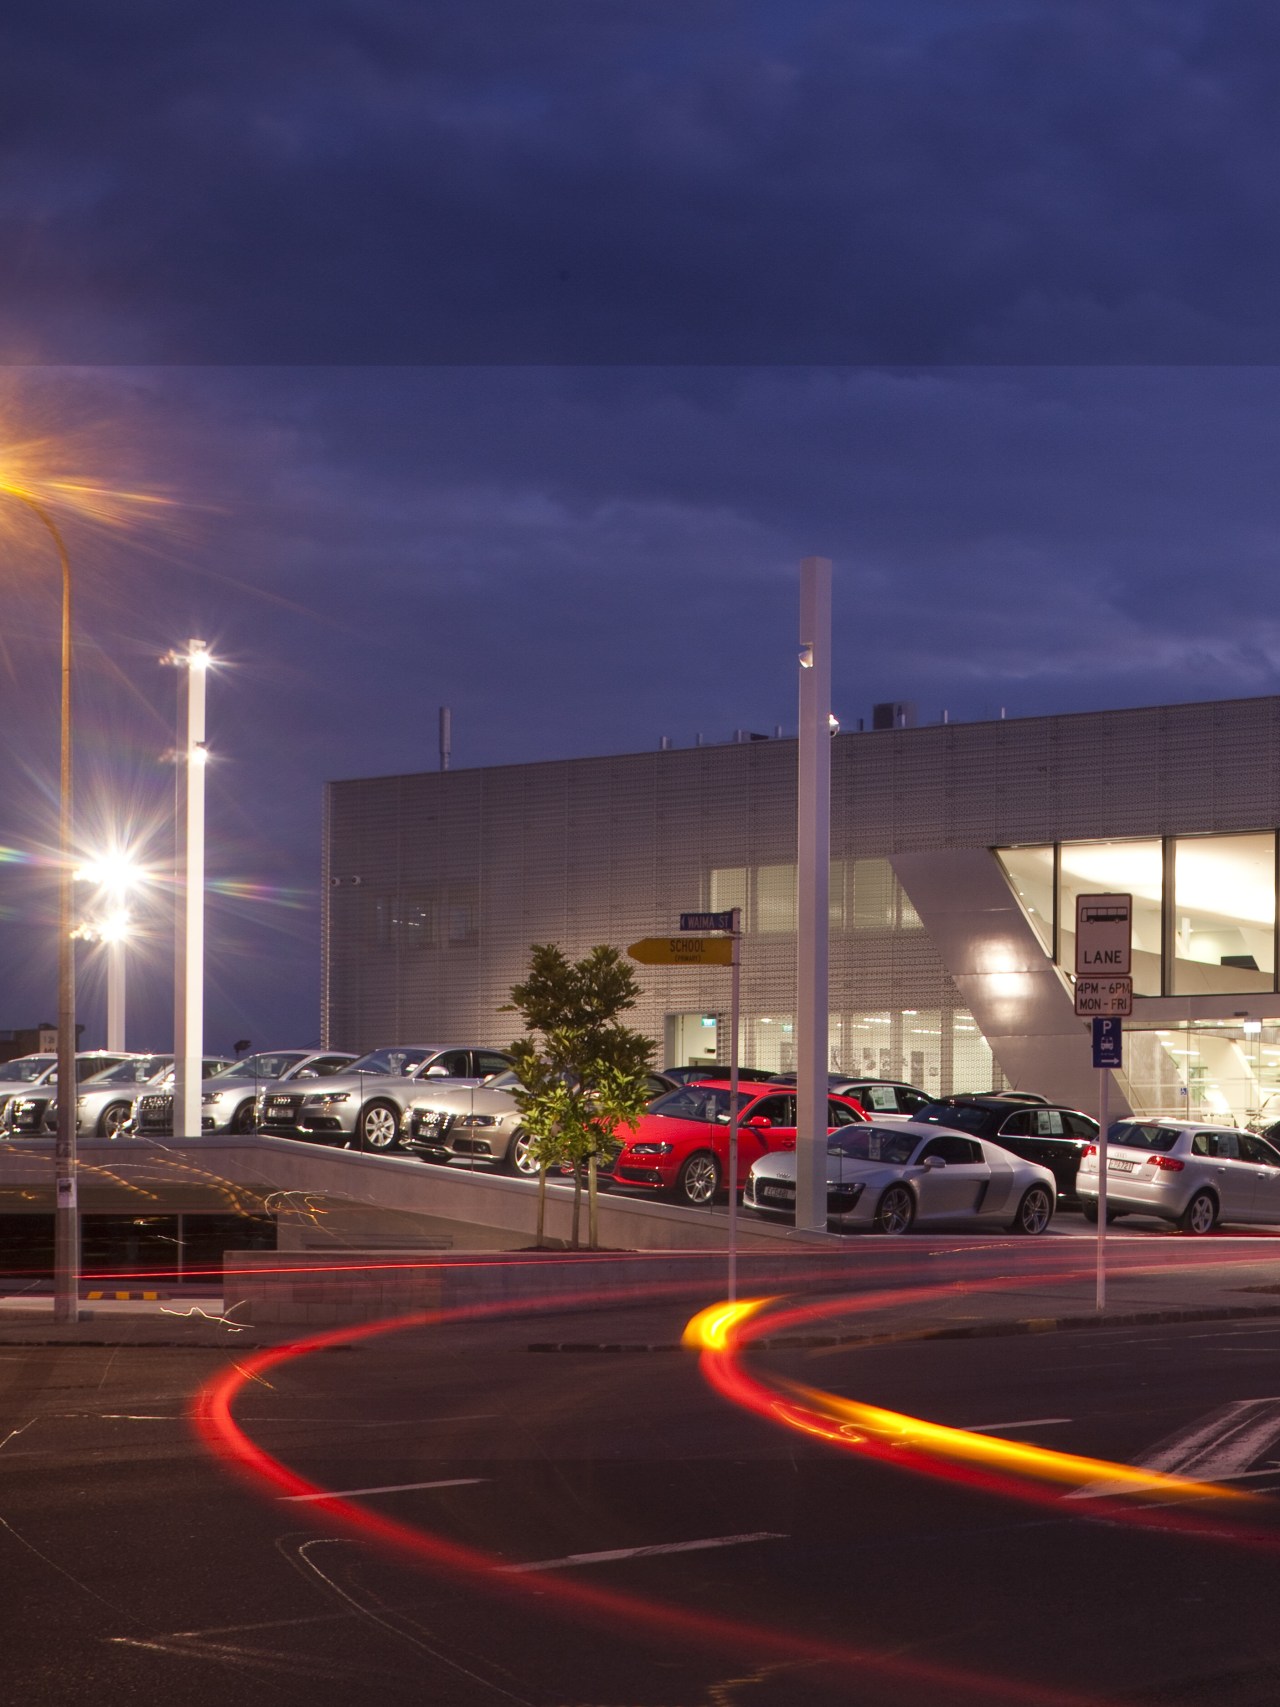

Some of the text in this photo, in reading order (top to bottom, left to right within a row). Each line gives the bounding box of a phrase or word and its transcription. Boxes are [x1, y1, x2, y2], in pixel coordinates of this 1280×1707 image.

[688, 916, 729, 929] WAIMA ST
[670, 940, 705, 952] SCHOOL
[1083, 950, 1122, 964] LANE
[1078, 983, 1099, 994] 4PM
[1108, 982, 1130, 994] 6PM
[1080, 999, 1101, 1010] MON
[1111, 998, 1127, 1010] FRI
[1102, 1020, 1112, 1034] P
